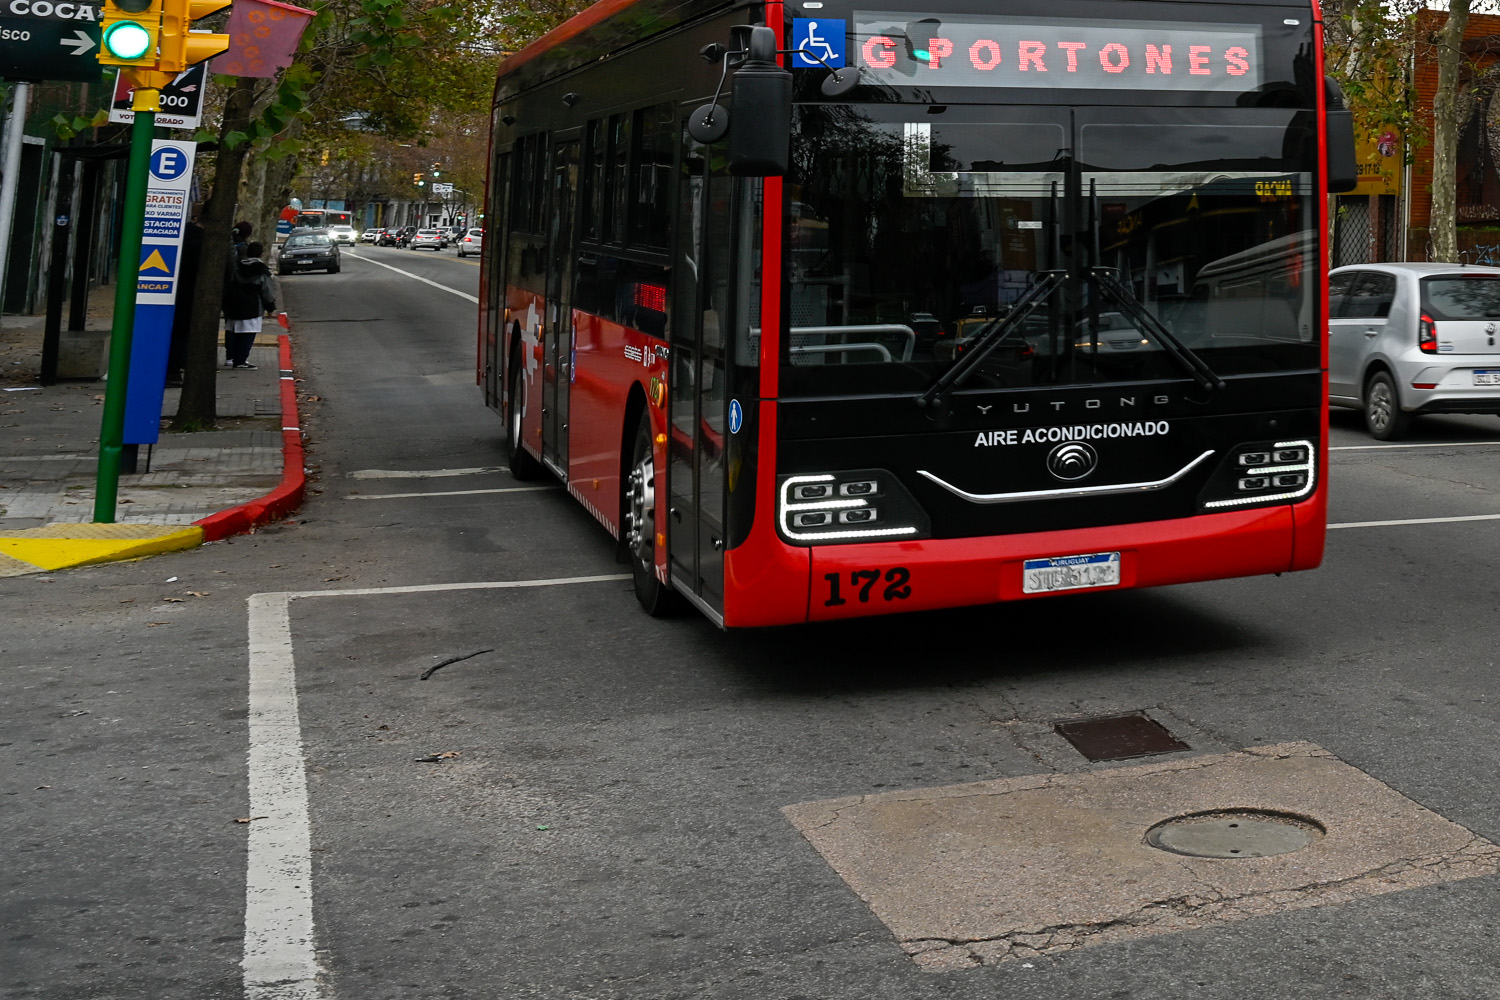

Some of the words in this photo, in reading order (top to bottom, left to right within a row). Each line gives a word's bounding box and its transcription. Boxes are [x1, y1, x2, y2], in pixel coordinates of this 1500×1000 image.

[10, 0, 96, 22] COCA
[862, 36, 897, 69] G
[928, 37, 1250, 77] PORTONES
[158, 152, 178, 175] E
[146, 195, 183, 205] GRATIS
[144, 220, 180, 228] STACIÓN
[977, 395, 1169, 415] YUTONG
[974, 430, 1018, 447] AIRE
[1021, 421, 1170, 444] ACONDICIONADO
[824, 567, 912, 607] 172
